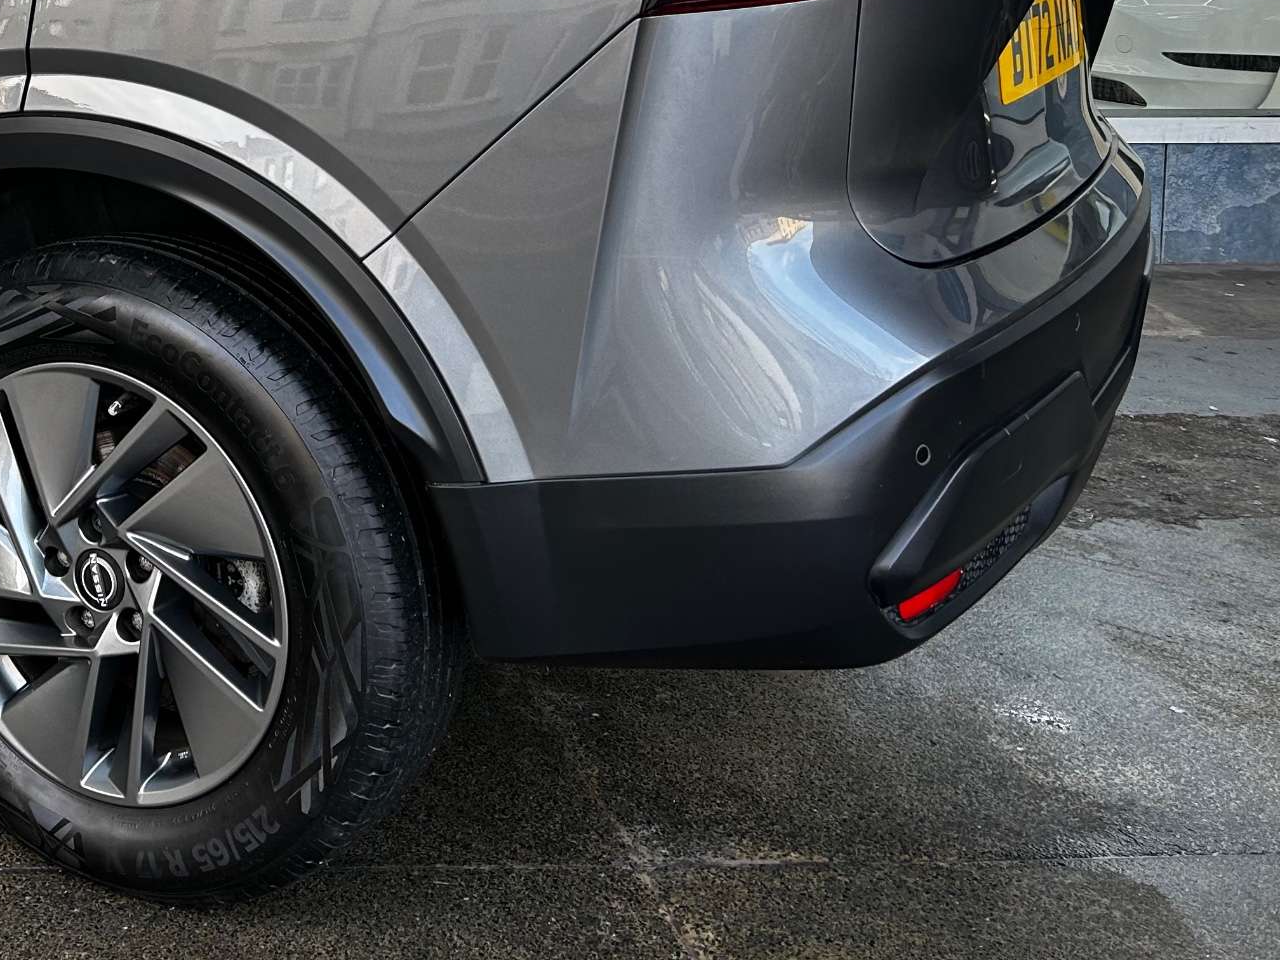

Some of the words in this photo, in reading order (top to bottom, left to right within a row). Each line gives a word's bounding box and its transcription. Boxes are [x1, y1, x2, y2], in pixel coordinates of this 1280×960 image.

[89, 553, 108, 607] NISSAN
[162, 846, 191, 878] R
[190, 804, 282, 873] 215/65
